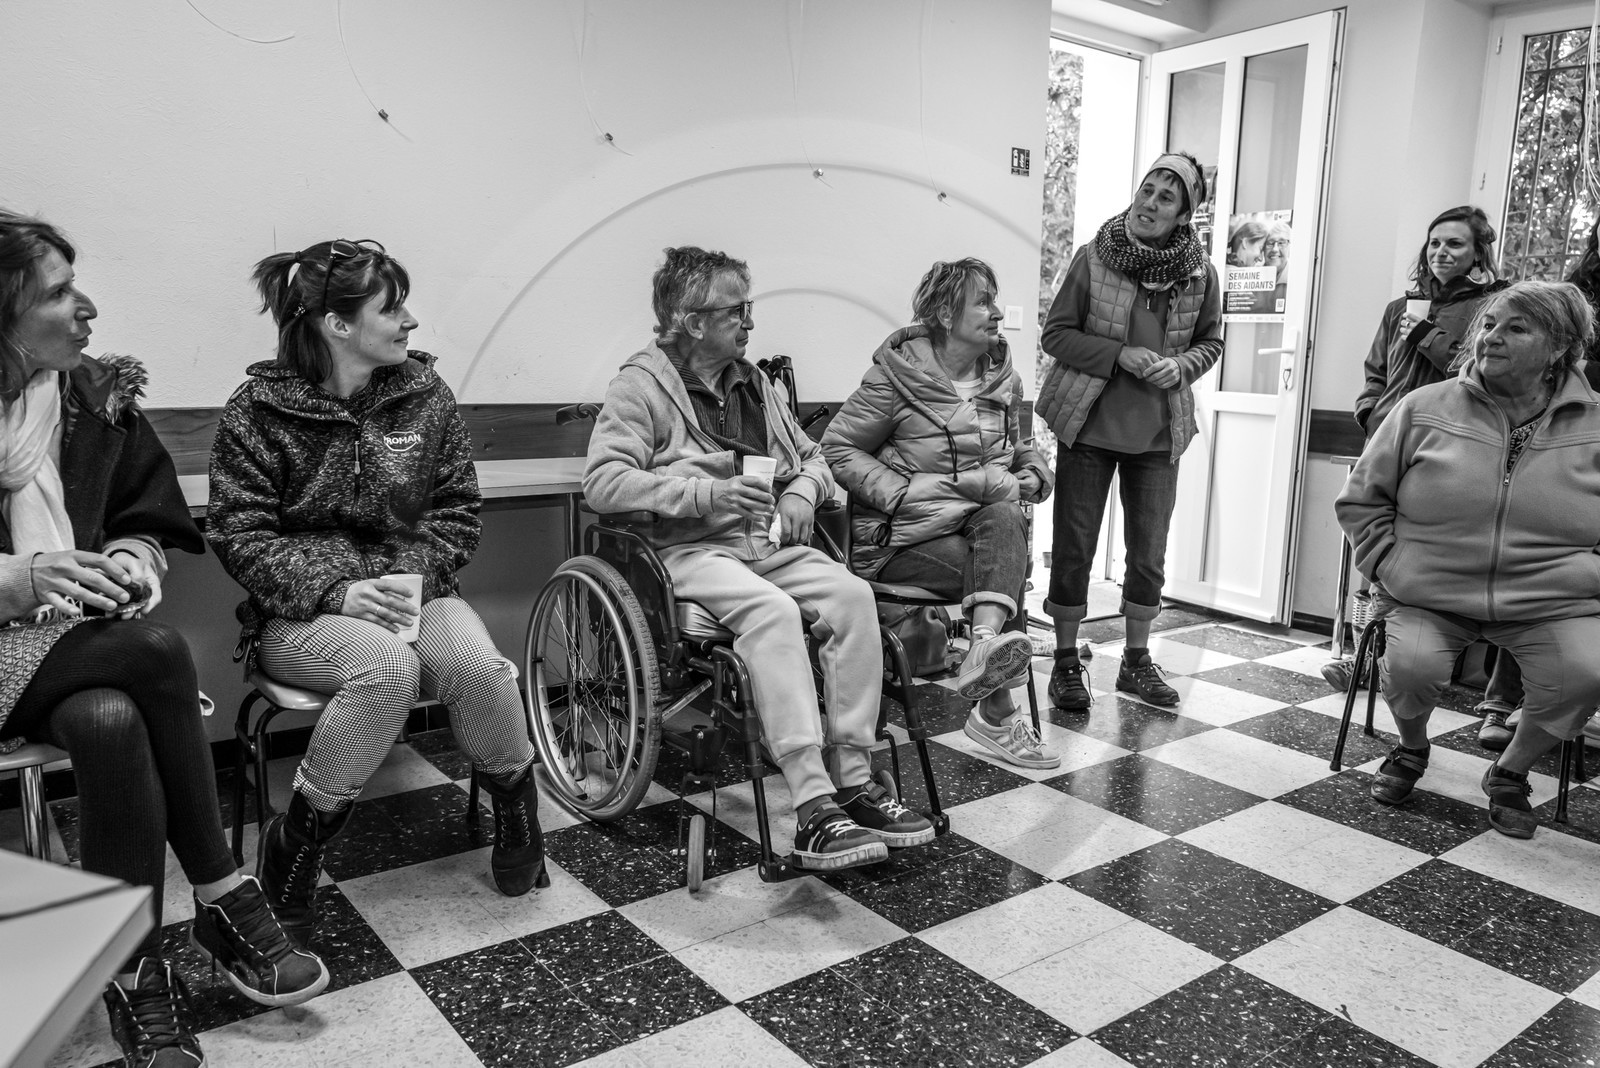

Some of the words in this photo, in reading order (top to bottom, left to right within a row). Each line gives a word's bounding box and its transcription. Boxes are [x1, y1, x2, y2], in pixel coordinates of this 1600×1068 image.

[1228, 271, 1260, 281] SEMAINE
[1228, 281, 1242, 290] DES
[1243, 280, 1274, 290] AIDANTS
